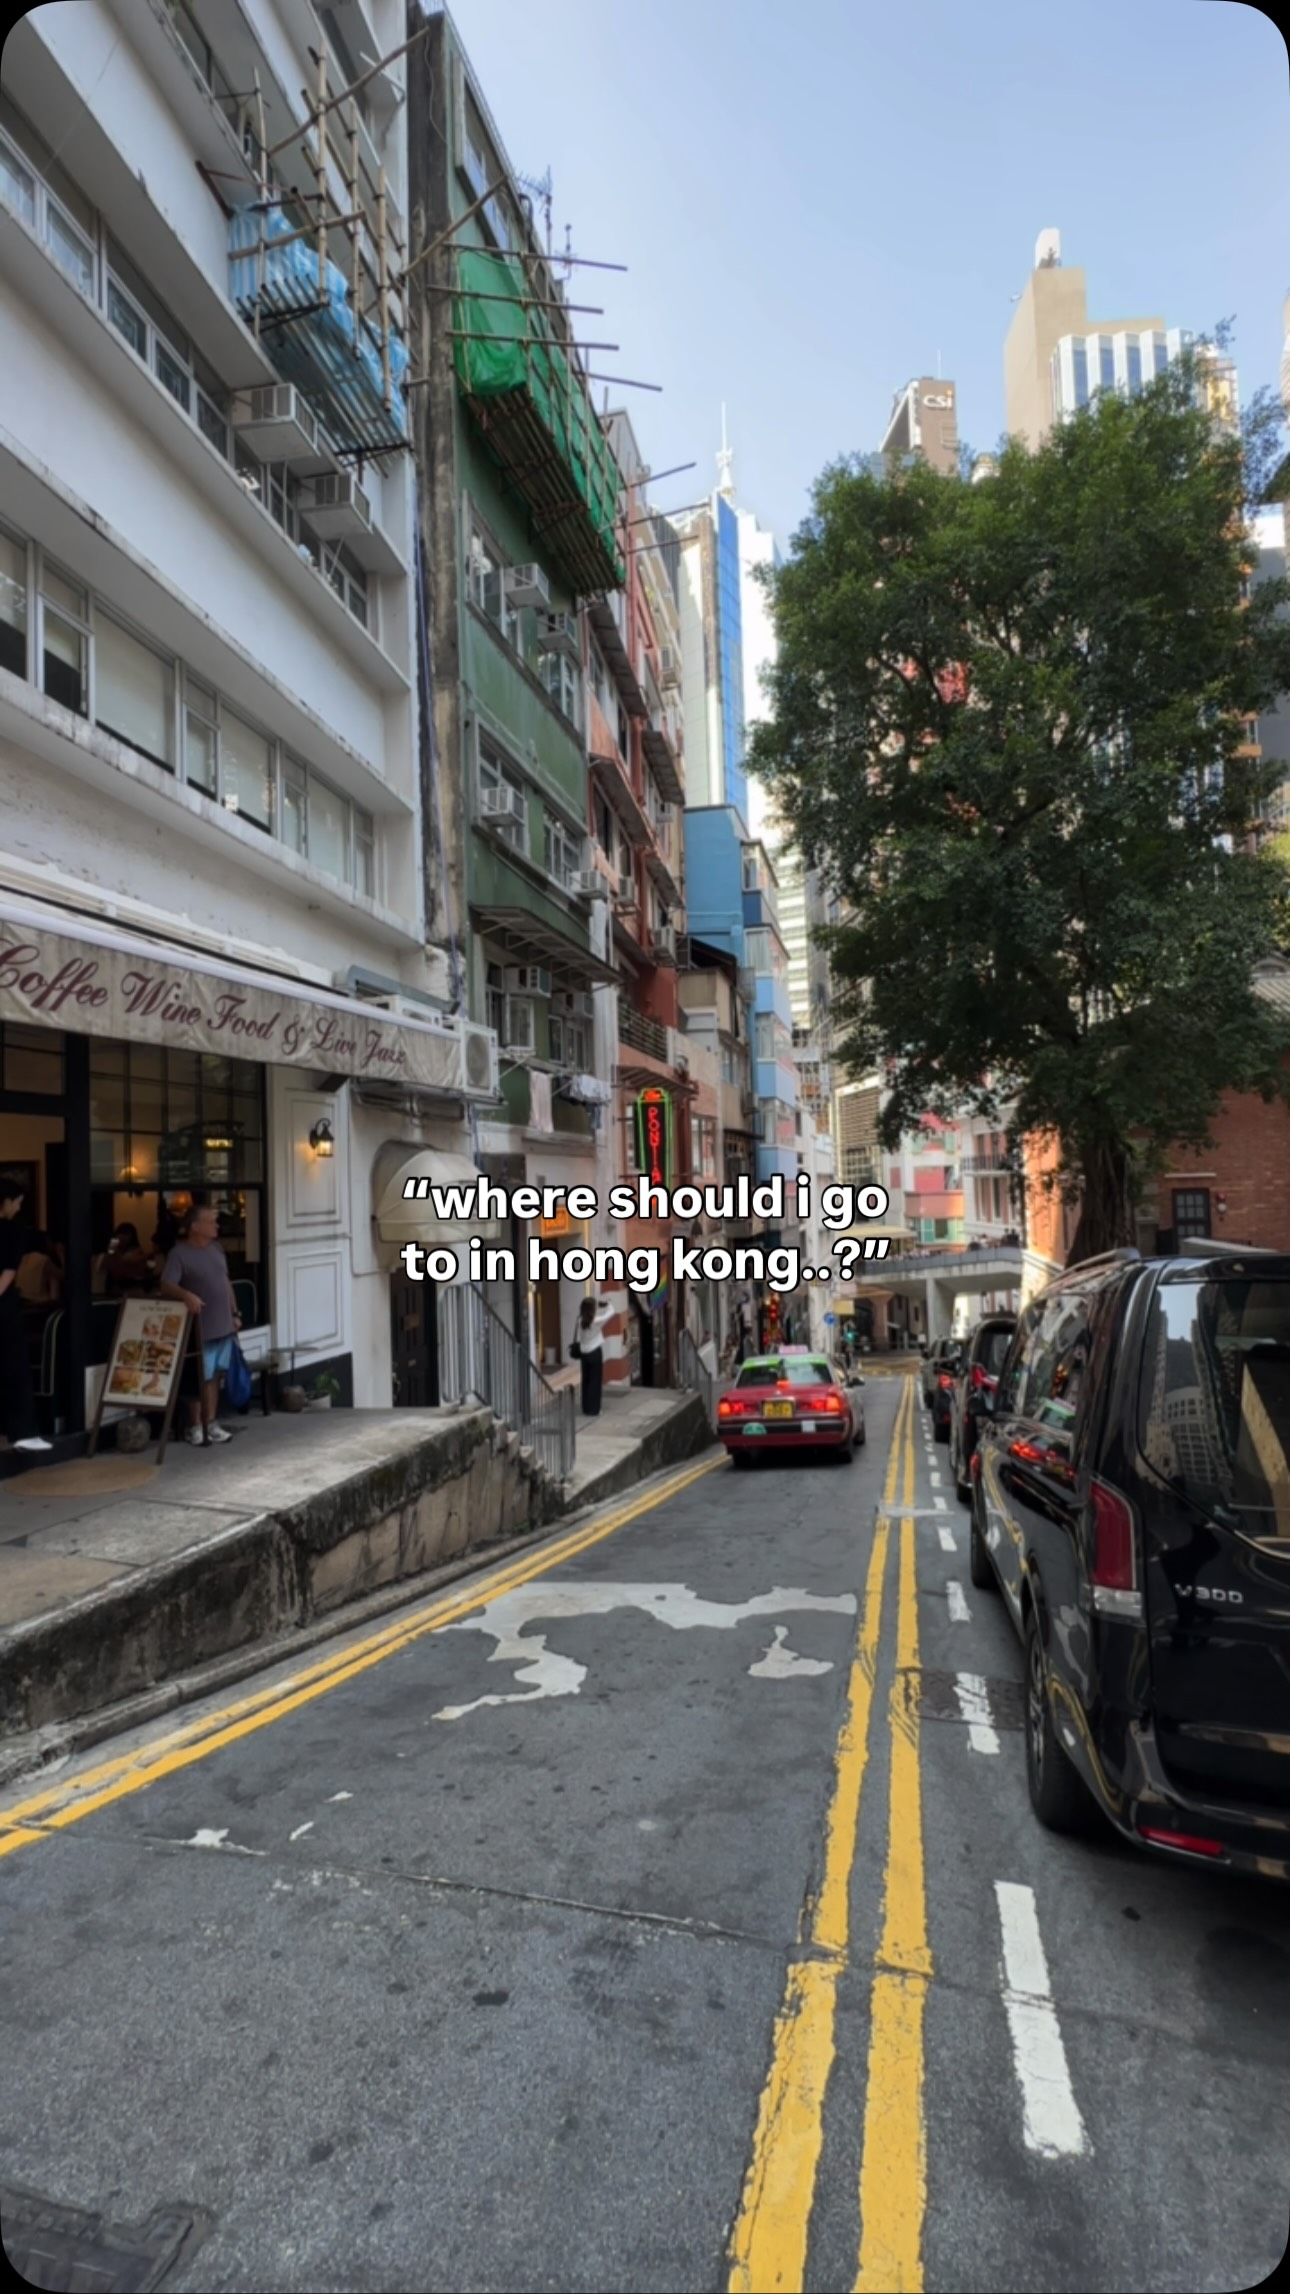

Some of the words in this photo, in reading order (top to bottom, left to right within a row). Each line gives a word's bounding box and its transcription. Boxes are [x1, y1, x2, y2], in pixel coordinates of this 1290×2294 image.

[0, 938, 109, 1012] Coffee
[120, 971, 202, 1026] Wine
[207, 994, 281, 1041] Food
[281, 1014, 305, 1056] &
[309, 1017, 358, 1056] Live
